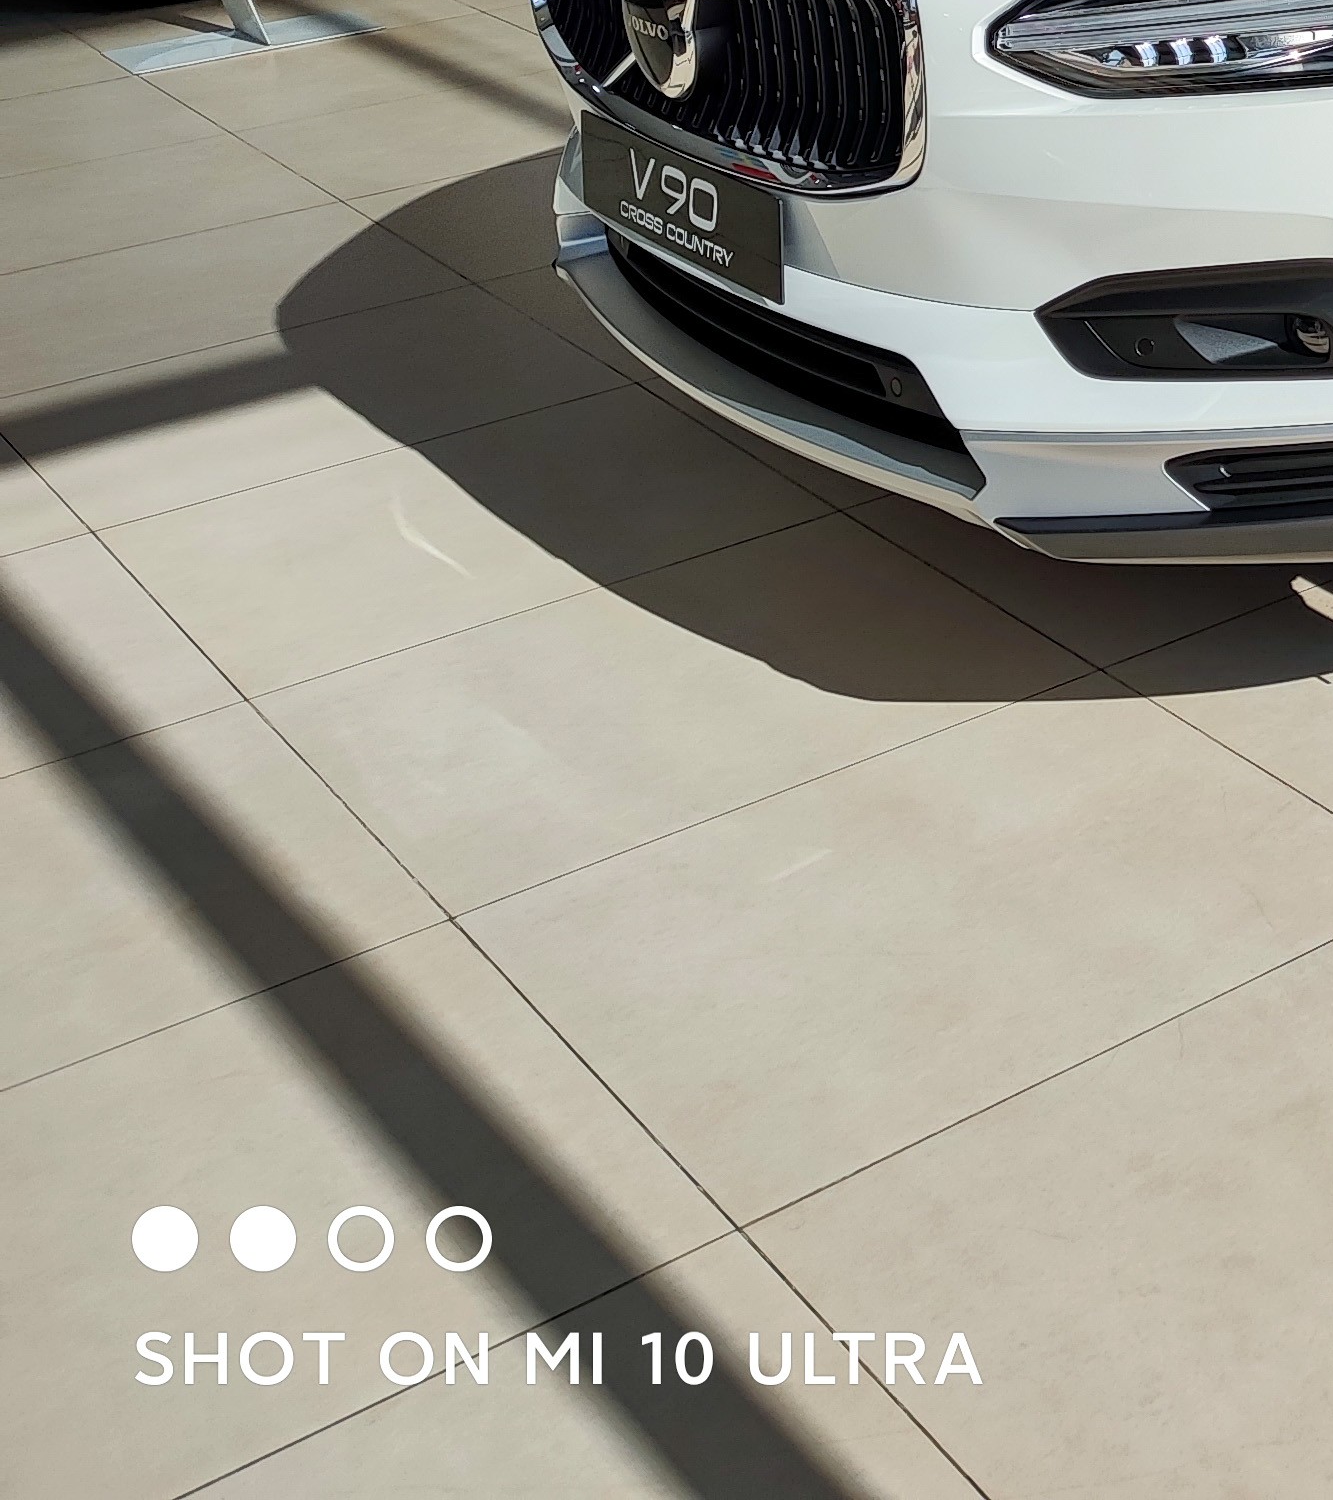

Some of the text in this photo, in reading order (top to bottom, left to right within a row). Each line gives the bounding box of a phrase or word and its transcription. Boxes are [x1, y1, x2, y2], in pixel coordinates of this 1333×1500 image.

[629, 14, 670, 41] OLVO
[619, 199, 735, 268] CROSS COUNTRY
